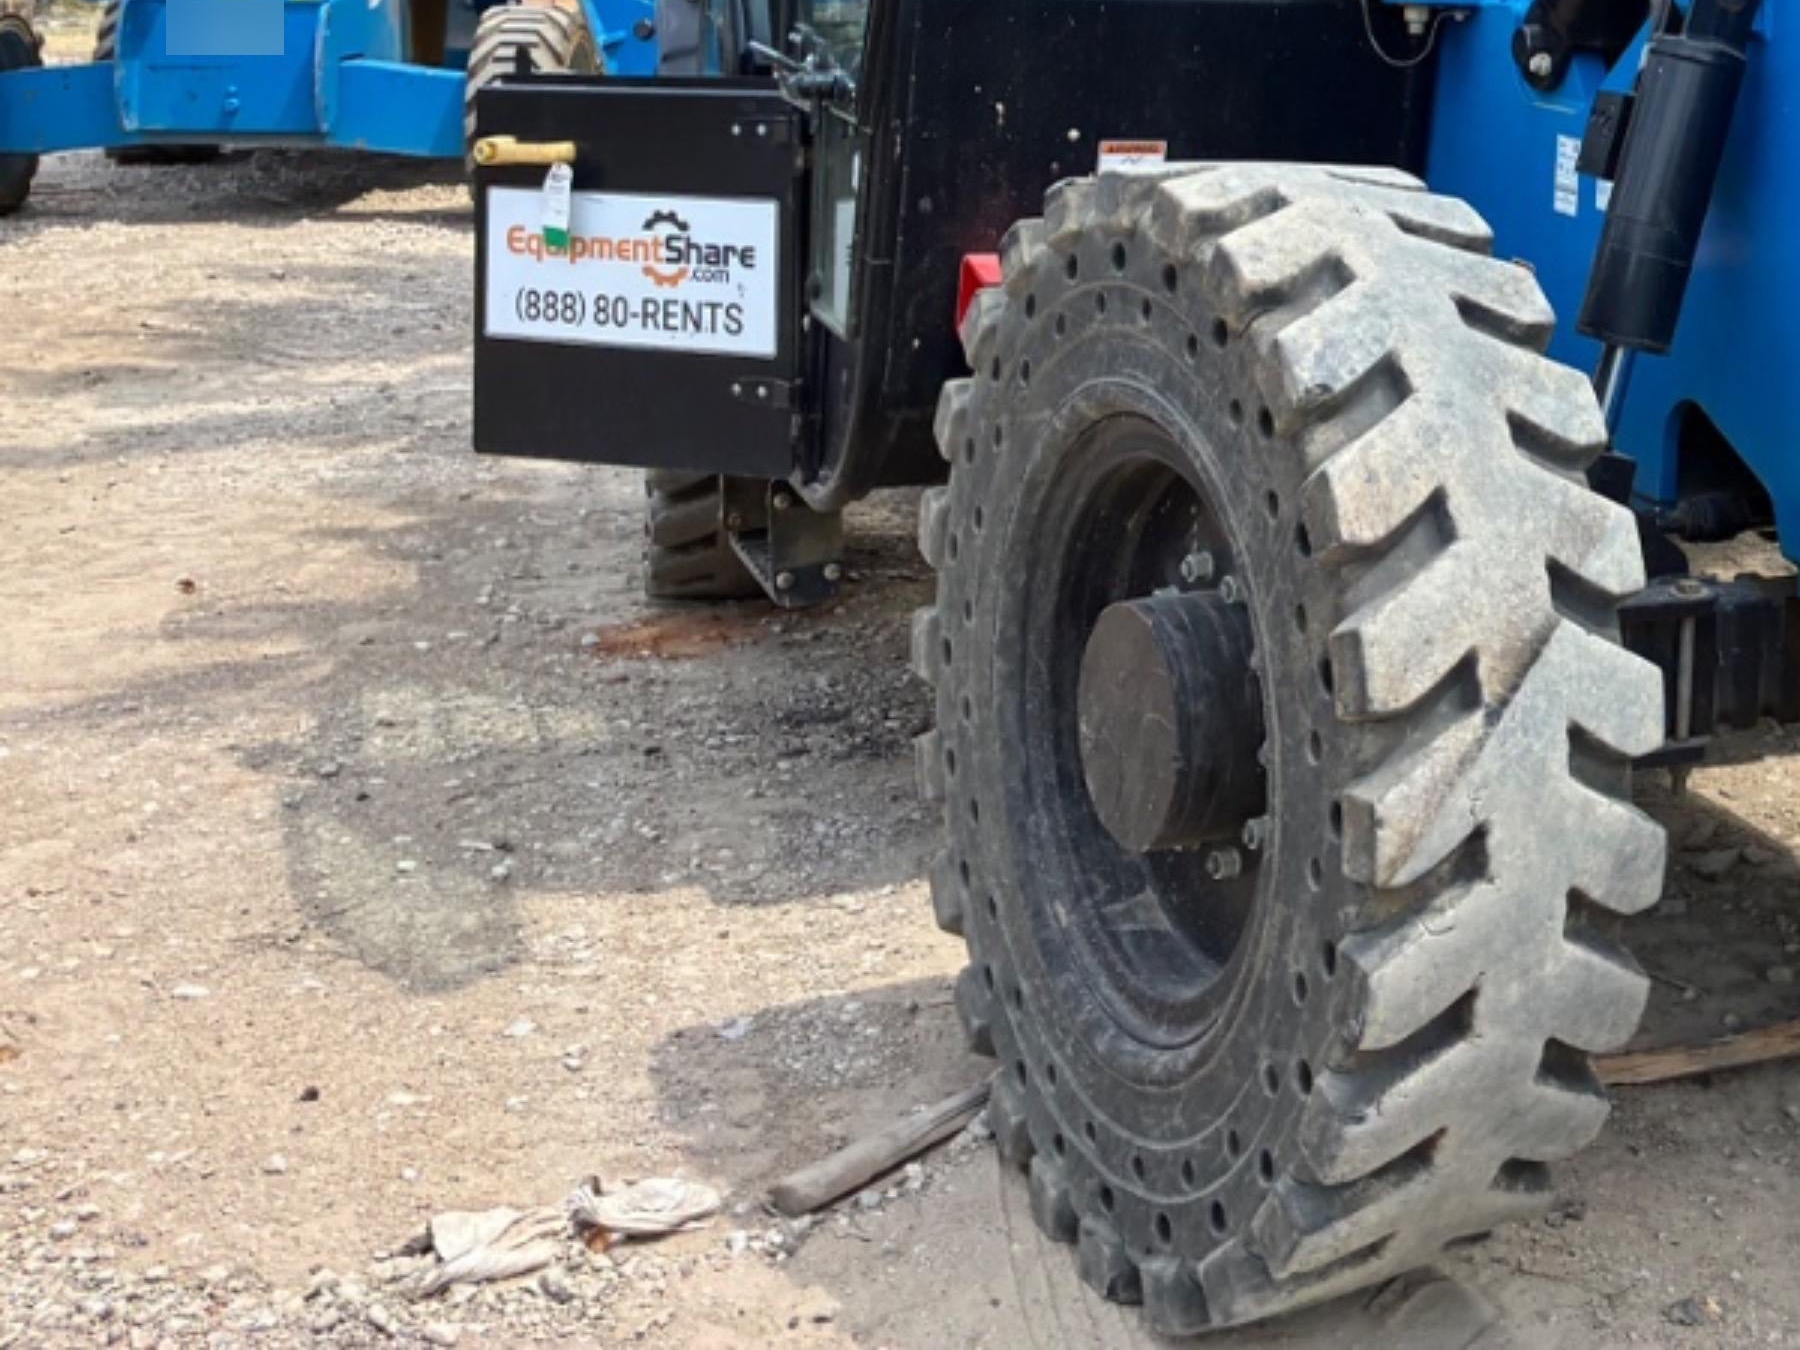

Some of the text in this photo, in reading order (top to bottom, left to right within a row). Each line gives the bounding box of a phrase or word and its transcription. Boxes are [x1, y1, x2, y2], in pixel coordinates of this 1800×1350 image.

[690, 267, 730, 285] .com
[515, 286, 744, 338] (888) 80-RENTS
